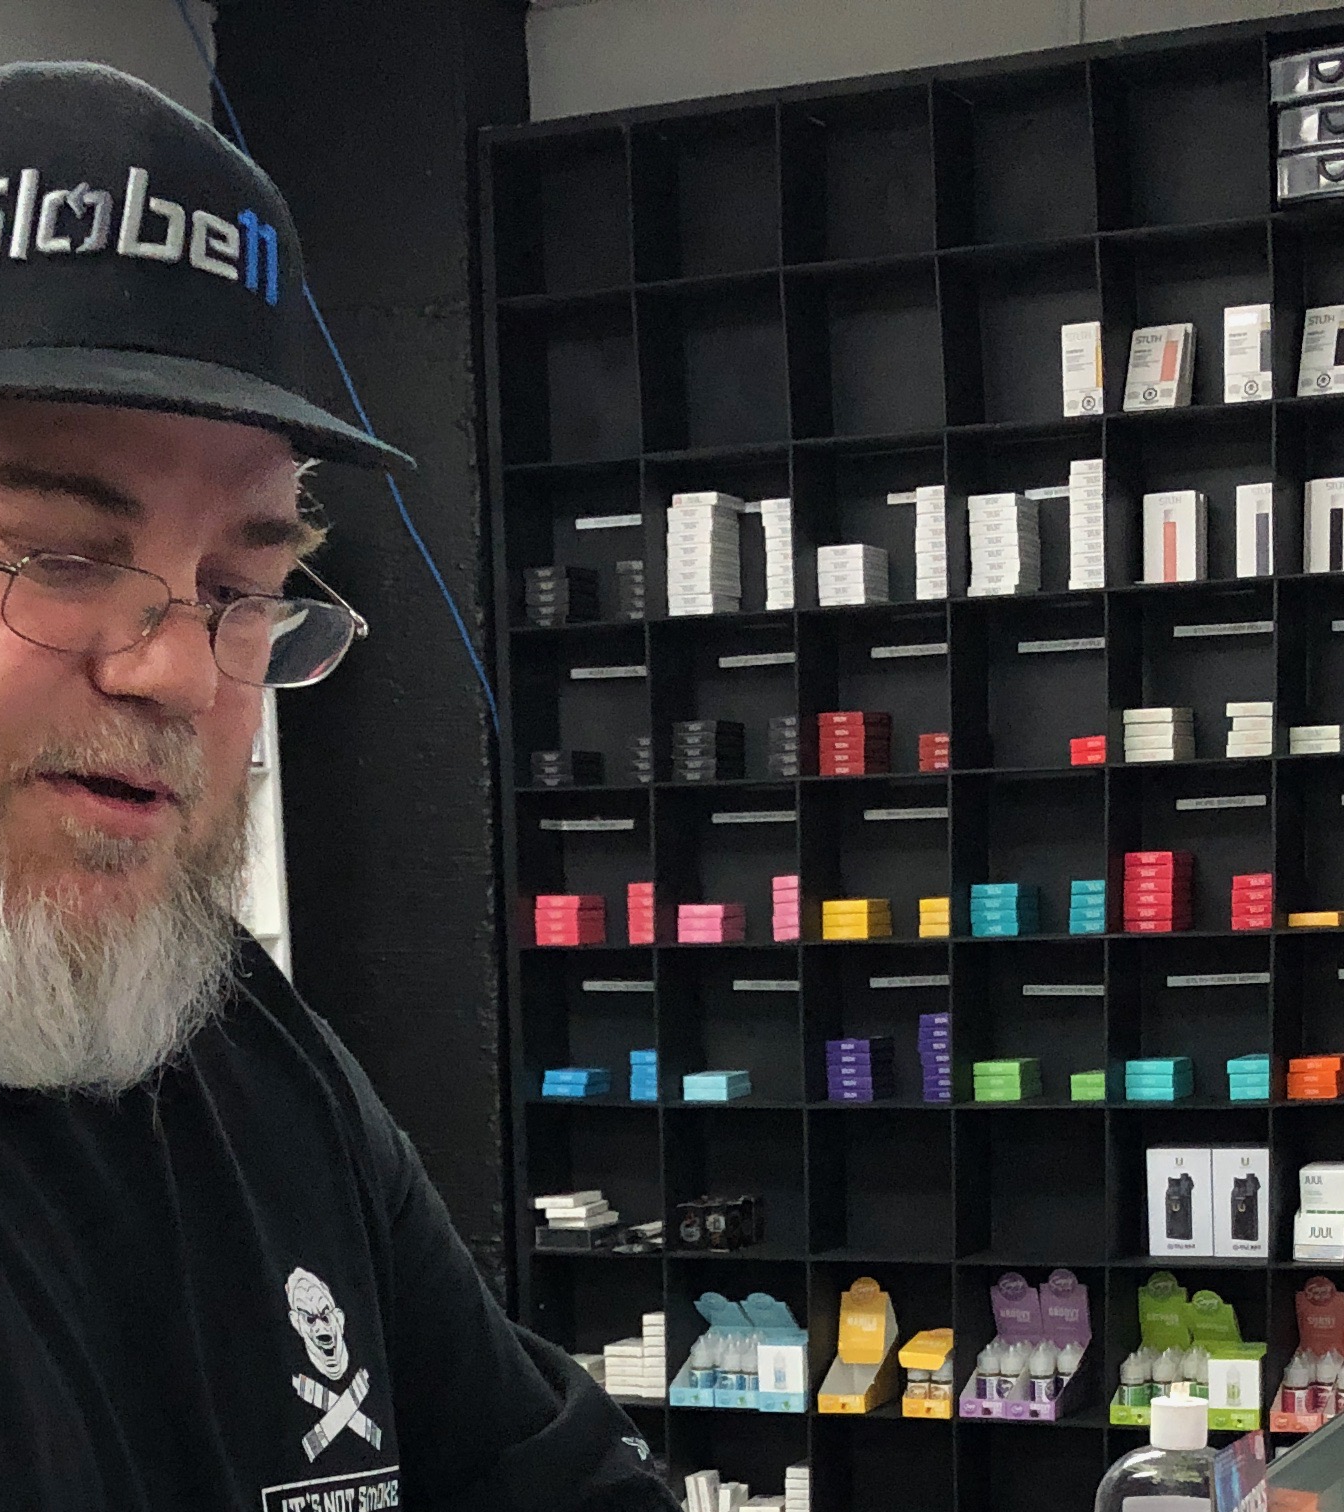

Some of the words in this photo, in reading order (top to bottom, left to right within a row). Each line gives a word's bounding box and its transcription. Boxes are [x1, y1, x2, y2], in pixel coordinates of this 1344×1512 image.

[1308, 314, 1335, 326] STLTH
[1135, 334, 1163, 345] STLTH
[1309, 1226, 1333, 1239] JUUL
